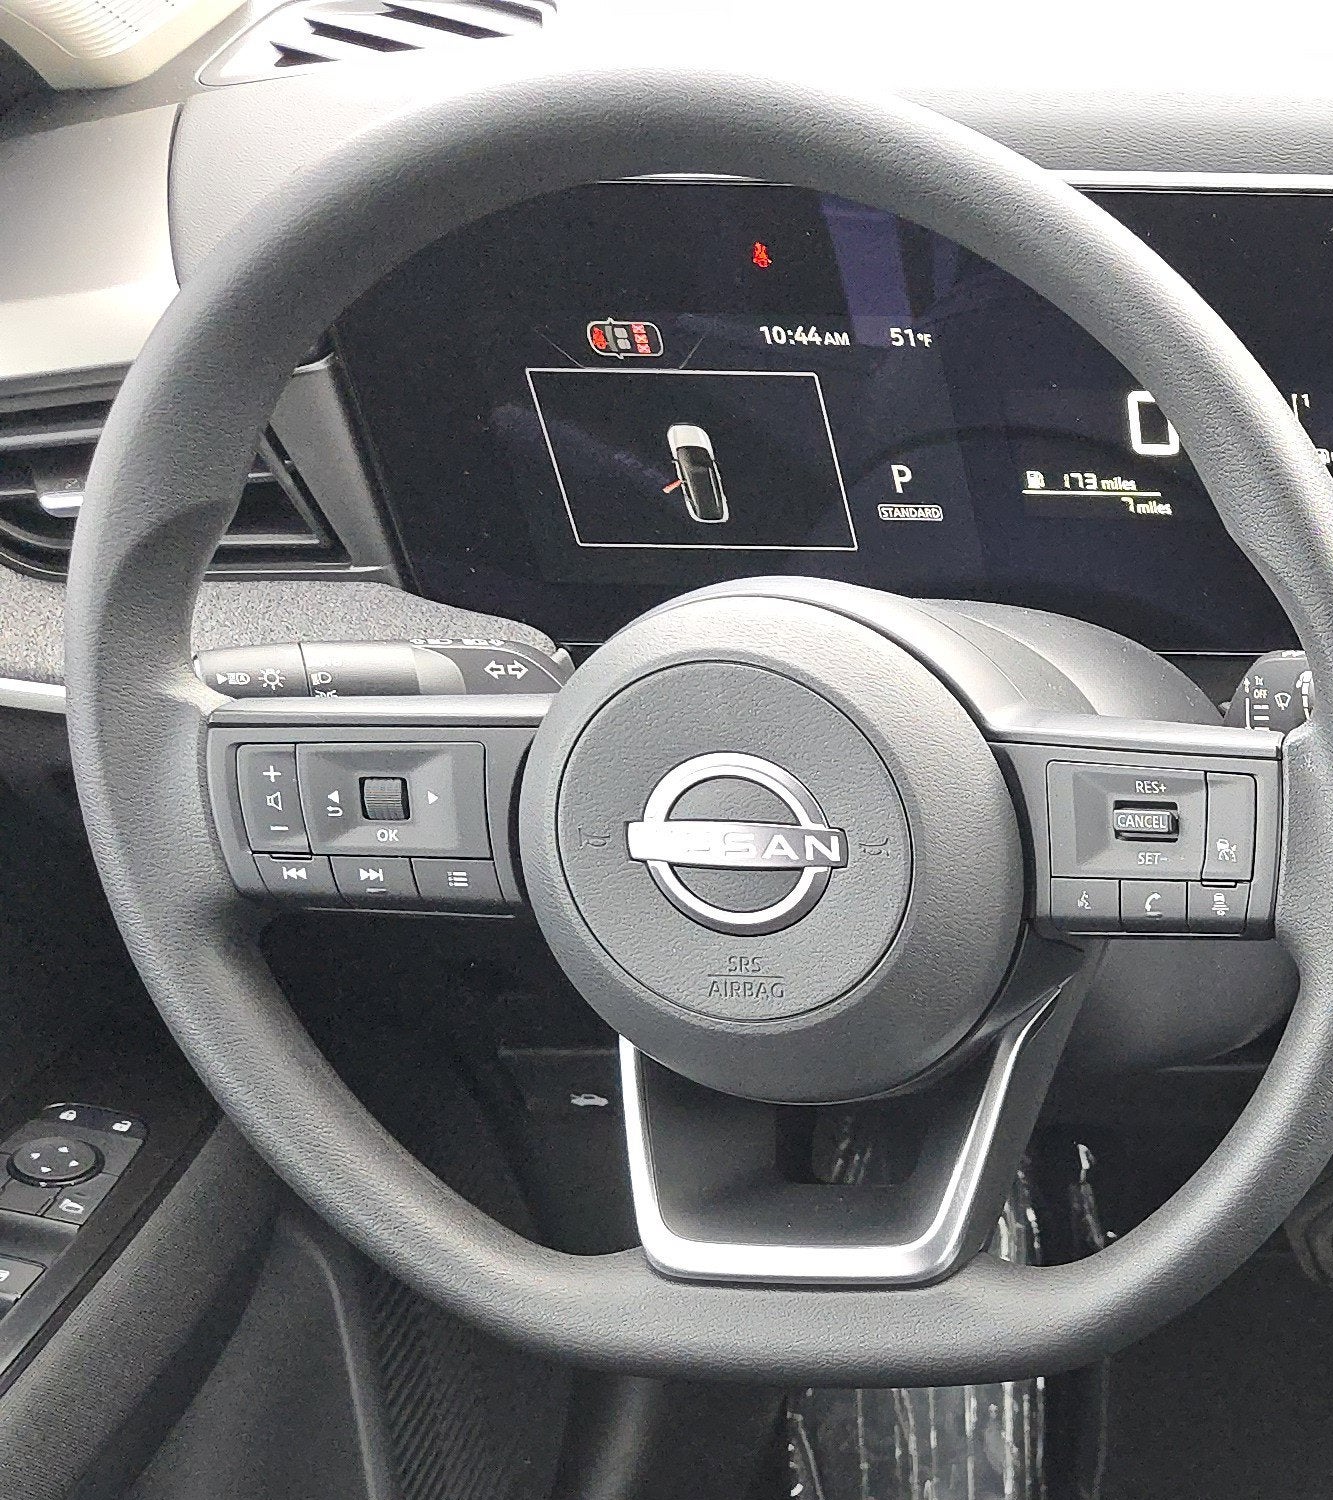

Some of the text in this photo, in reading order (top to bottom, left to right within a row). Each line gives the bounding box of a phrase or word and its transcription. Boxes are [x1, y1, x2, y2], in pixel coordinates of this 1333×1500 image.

[891, 465, 913, 493] P
[1064, 473, 1136, 491] 173 miles
[880, 506, 941, 519] STANDARD
[1120, 497, 1172, 515] 7 miles
[1253, 689, 1268, 699] OFF
[1117, 814, 1167, 829] CANCEL
[376, 830, 399, 842] OK
[728, 956, 762, 974] SRS
[708, 980, 785, 999] AIRBAG
